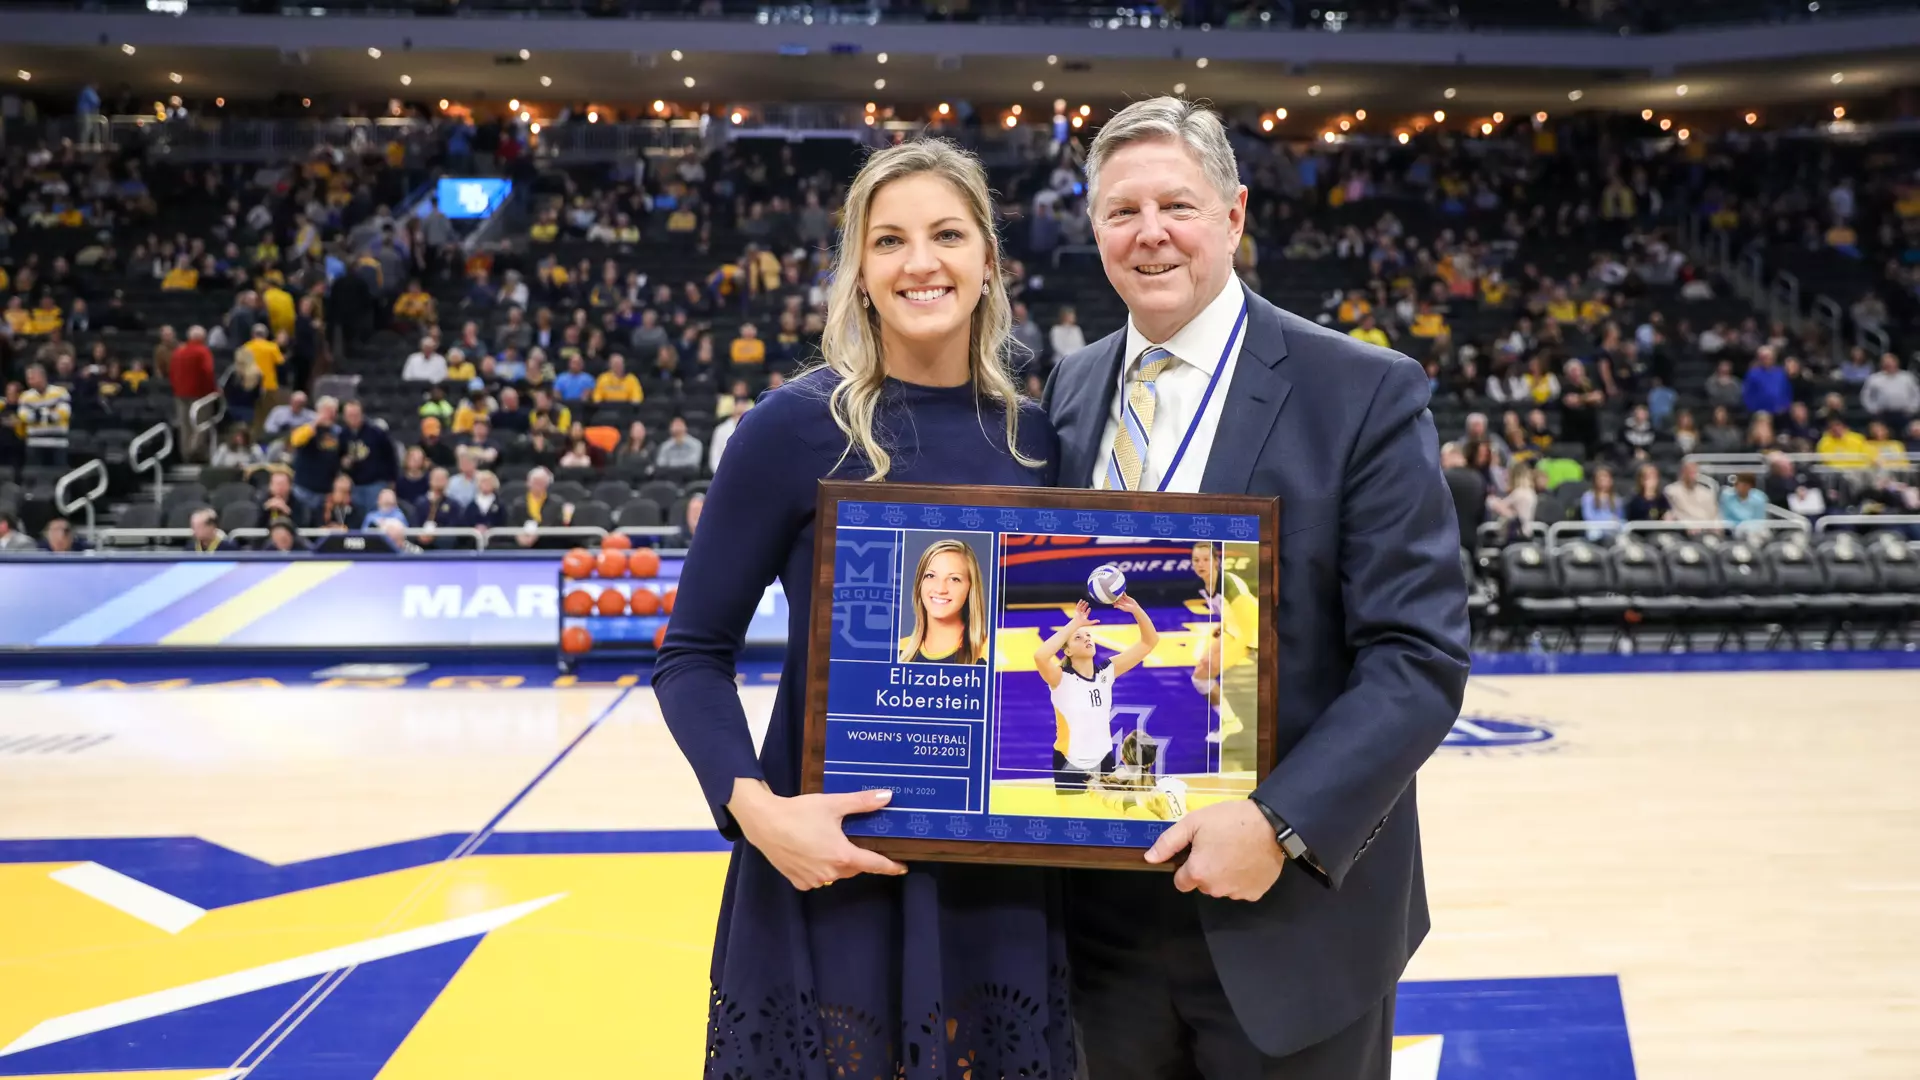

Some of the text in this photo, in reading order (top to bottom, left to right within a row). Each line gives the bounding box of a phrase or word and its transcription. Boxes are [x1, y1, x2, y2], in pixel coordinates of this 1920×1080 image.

[890, 667, 981, 688] Elizabeth
[876, 689, 980, 710] Koberstein
[1089, 688, 1102, 707] 18
[847, 731, 967, 745] WOMEN'S VOLLEYBALL
[913, 746, 966, 757] 2012-2013
[904, 787, 914, 795] IN
[916, 788, 936, 796] 2020
